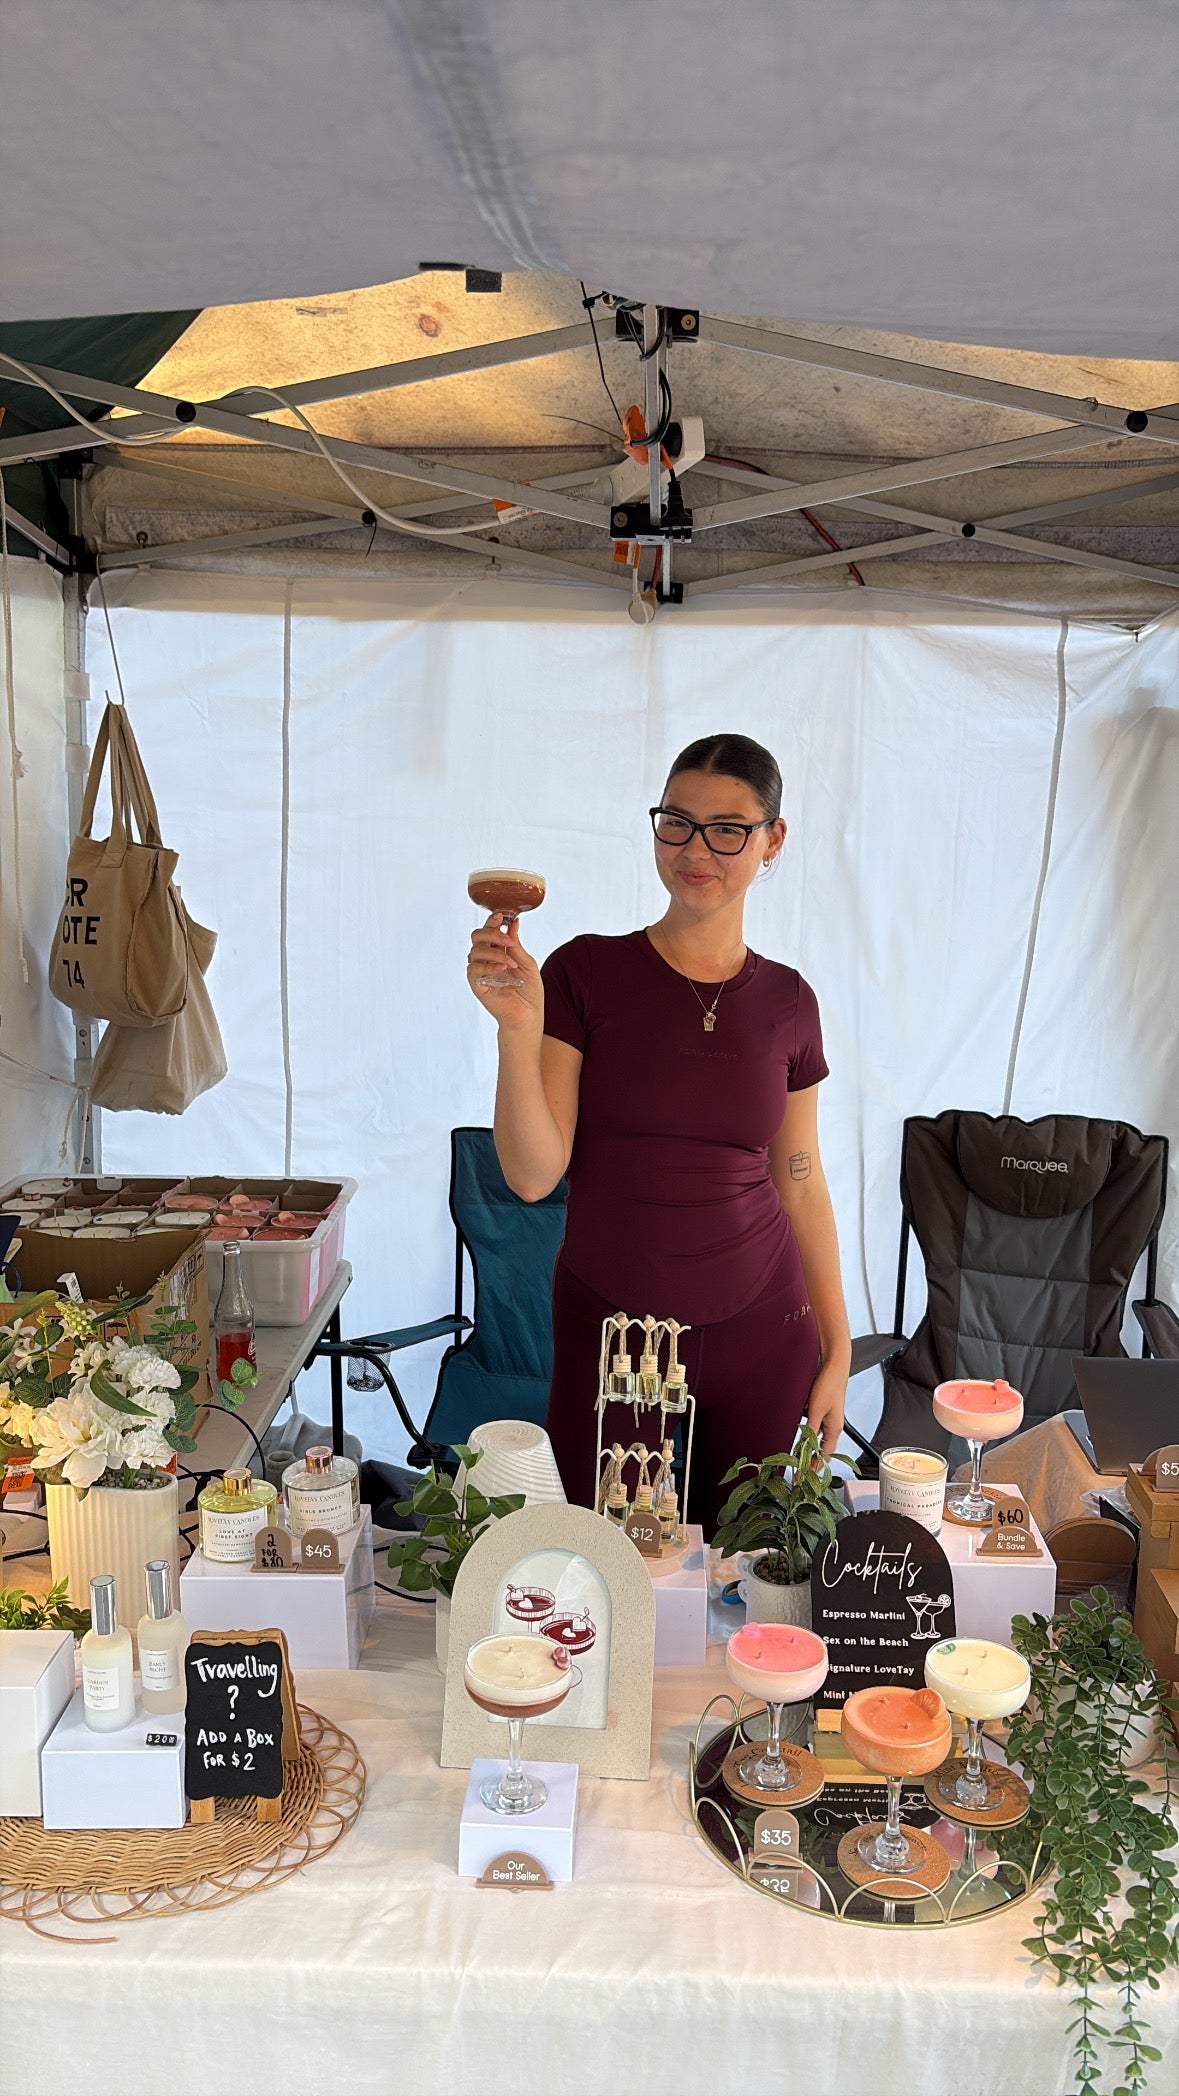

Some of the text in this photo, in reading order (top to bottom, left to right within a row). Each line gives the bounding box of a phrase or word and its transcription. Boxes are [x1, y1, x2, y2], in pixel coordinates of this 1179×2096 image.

[1001, 1156, 1069, 1174] Marquee
[997, 1508, 1024, 1526] $60
[267, 1533, 277, 1548] 2
[630, 1526, 654, 1542] $12
[998, 1532, 1026, 1542] Bundle
[261, 1548, 278, 1557] FOR
[305, 1544, 332, 1558] $45
[996, 1542, 1026, 1550] & Save
[821, 1539, 923, 1595] Cocktails
[822, 1609, 906, 1621] Espresso Martini
[822, 1636, 841, 1645] Sex
[860, 1636, 876, 1646] the
[879, 1637, 909, 1647] Beach
[190, 1655, 278, 1698] Travelling
[826, 1664, 915, 1676] ignature LoveTay
[823, 1690, 846, 1699] Mint
[227, 1684, 239, 1720] ?
[760, 1828, 792, 1846] $35
[506, 1860, 525, 1870] Our
[492, 1869, 541, 1881] Best Seller
